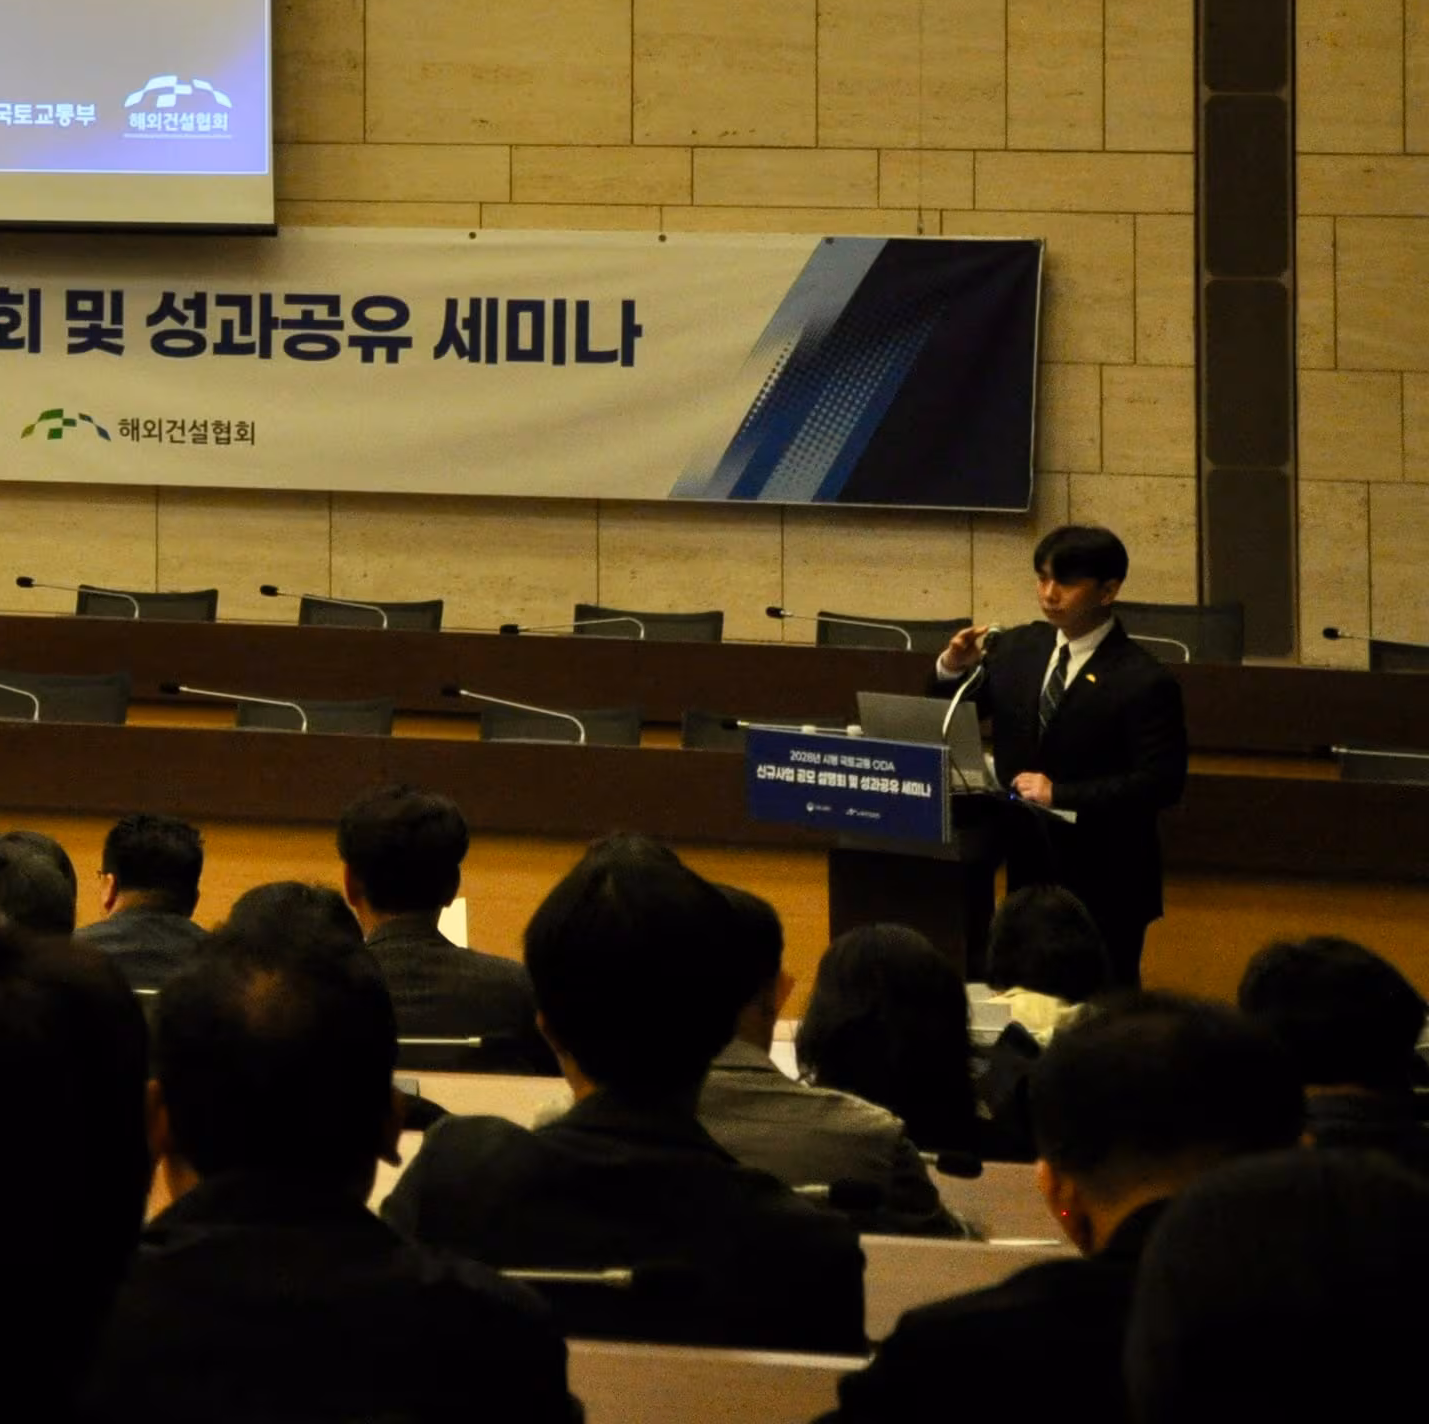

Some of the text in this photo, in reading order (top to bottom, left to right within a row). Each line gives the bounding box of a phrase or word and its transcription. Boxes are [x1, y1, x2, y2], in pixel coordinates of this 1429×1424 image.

[129, 112, 228, 132] 해외건설협회
[65, 289, 125, 356] 및
[146, 290, 413, 364] 성과공유
[433, 297, 643, 367] 세미나
[118, 417, 256, 445] 해외건설협회
[873, 757, 895, 772] ODA
[757, 764, 794, 781] 신규사업
[797, 769, 815, 784] 공모
[818, 771, 847, 788] 설명회
[860, 777, 899, 793] 성과공유
[901, 780, 932, 798] 세미나
